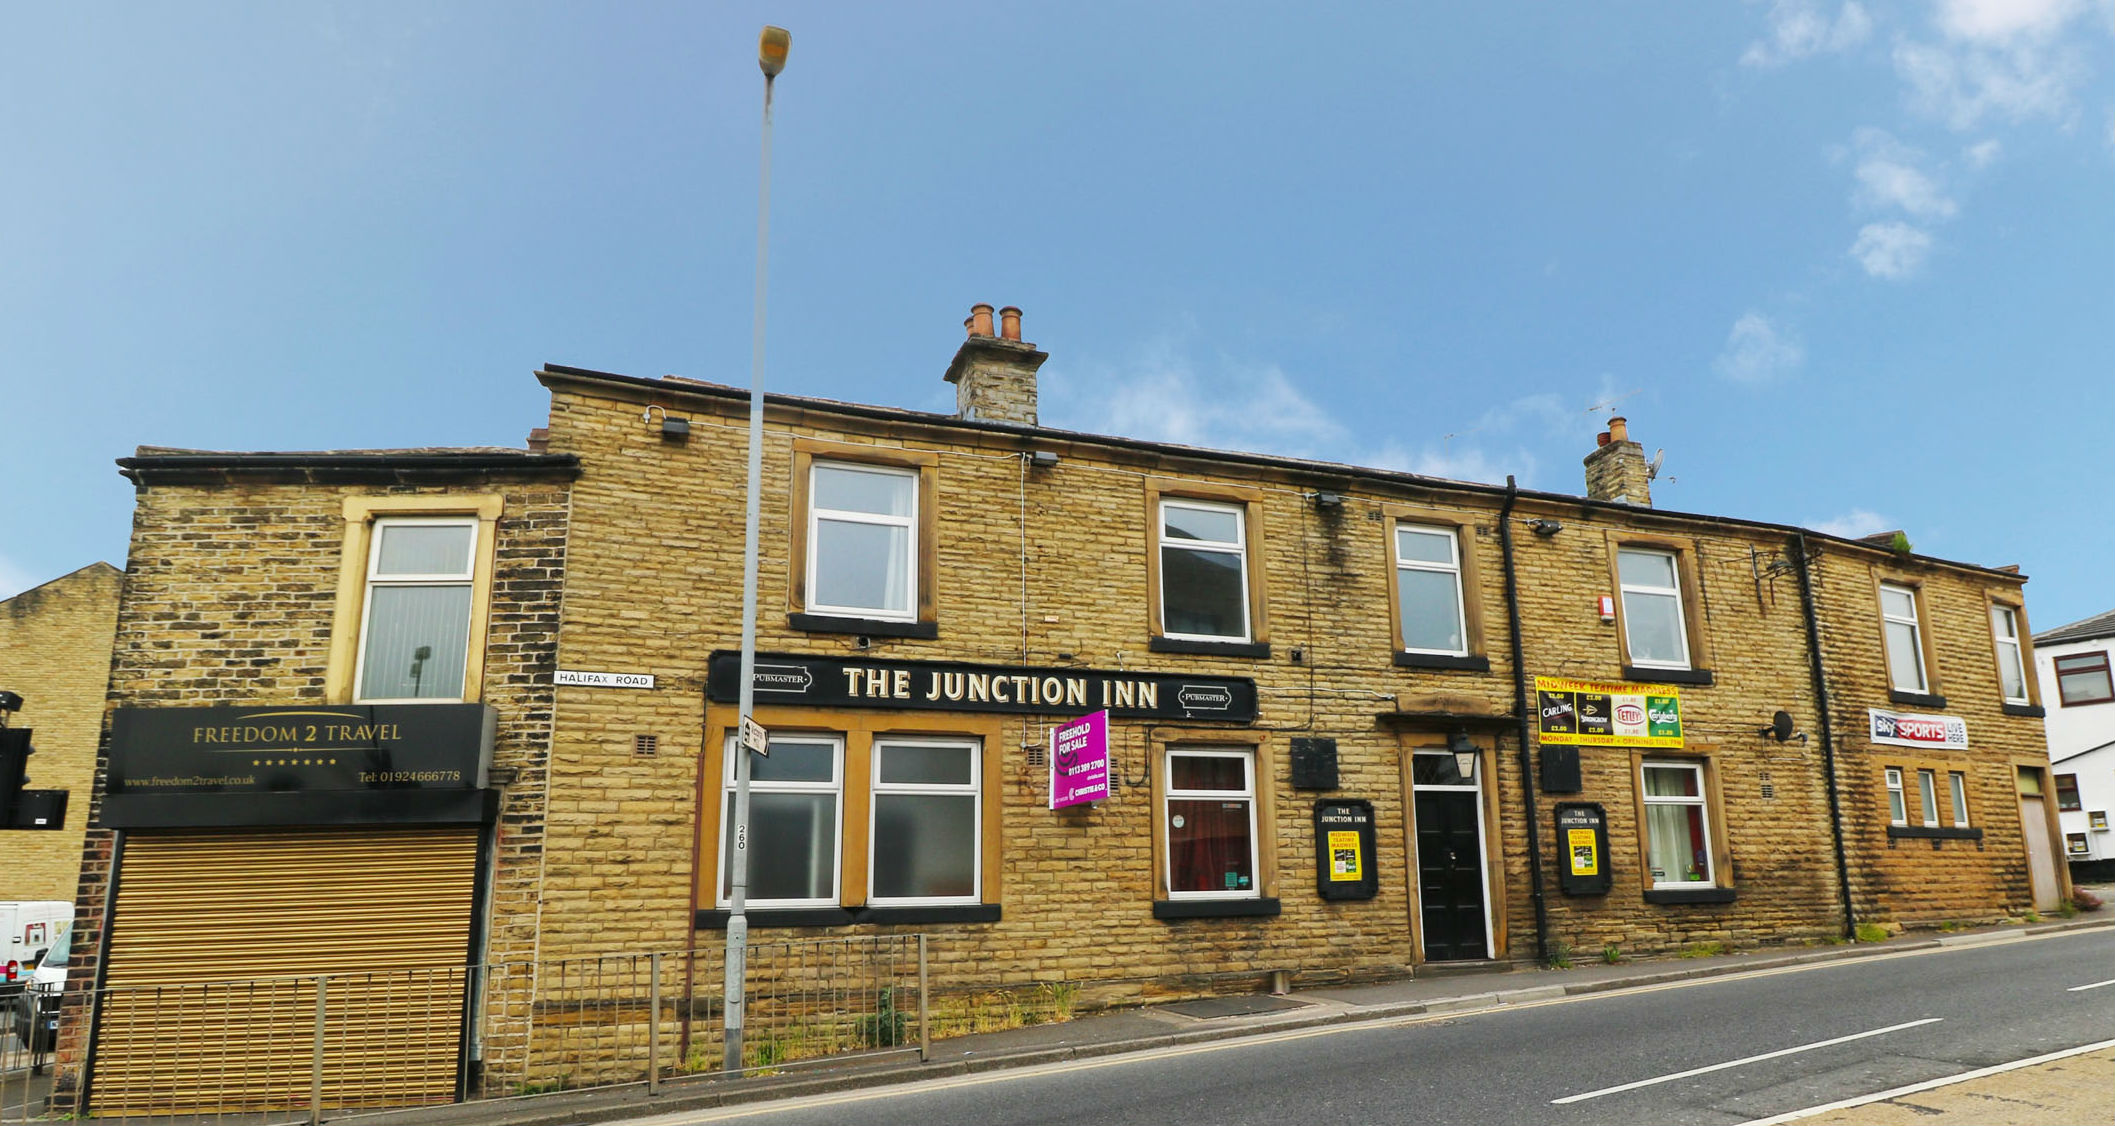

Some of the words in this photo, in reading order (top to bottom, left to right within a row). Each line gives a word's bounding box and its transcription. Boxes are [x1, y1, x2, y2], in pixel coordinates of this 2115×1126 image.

[560, 673, 608, 684] HALIFAX
[616, 675, 648, 686] ROAD
[753, 673, 804, 684] PUBMASTER
[843, 667, 911, 699] THE
[926, 672, 1086, 705] JUNCTION
[1102, 680, 1158, 709] INN
[1590, 682, 1627, 694] TEATIME
[1632, 685, 1678, 696] MADNESS
[1185, 693, 1226, 702] PUBMASTER
[1542, 703, 1573, 718] CARLING
[193, 726, 297, 743] FREEDOM
[304, 725, 317, 742] 2
[325, 724, 402, 741] TRAVEL
[1059, 723, 1090, 742] FREEHOLD
[1876, 717, 1897, 736] sky
[1900, 721, 1945, 739] SPORTS
[1947, 722, 1963, 733] LIVE
[1541, 735, 1573, 743] MONDAY
[1580, 736, 1614, 744] THURSDAY
[1947, 733, 1964, 743] HERE
[1059, 741, 1070, 755] FOR
[1071, 736, 1087, 751] SALE
[380, 771, 461, 783] 01924666778
[1068, 766, 1080, 776] 0113
[124, 775, 255, 787] www.freedom2travel.co.uk
[1337, 807, 1350, 815] THE
[1321, 815, 1352, 823] JUNCTION
[1354, 815, 1367, 823] INN
